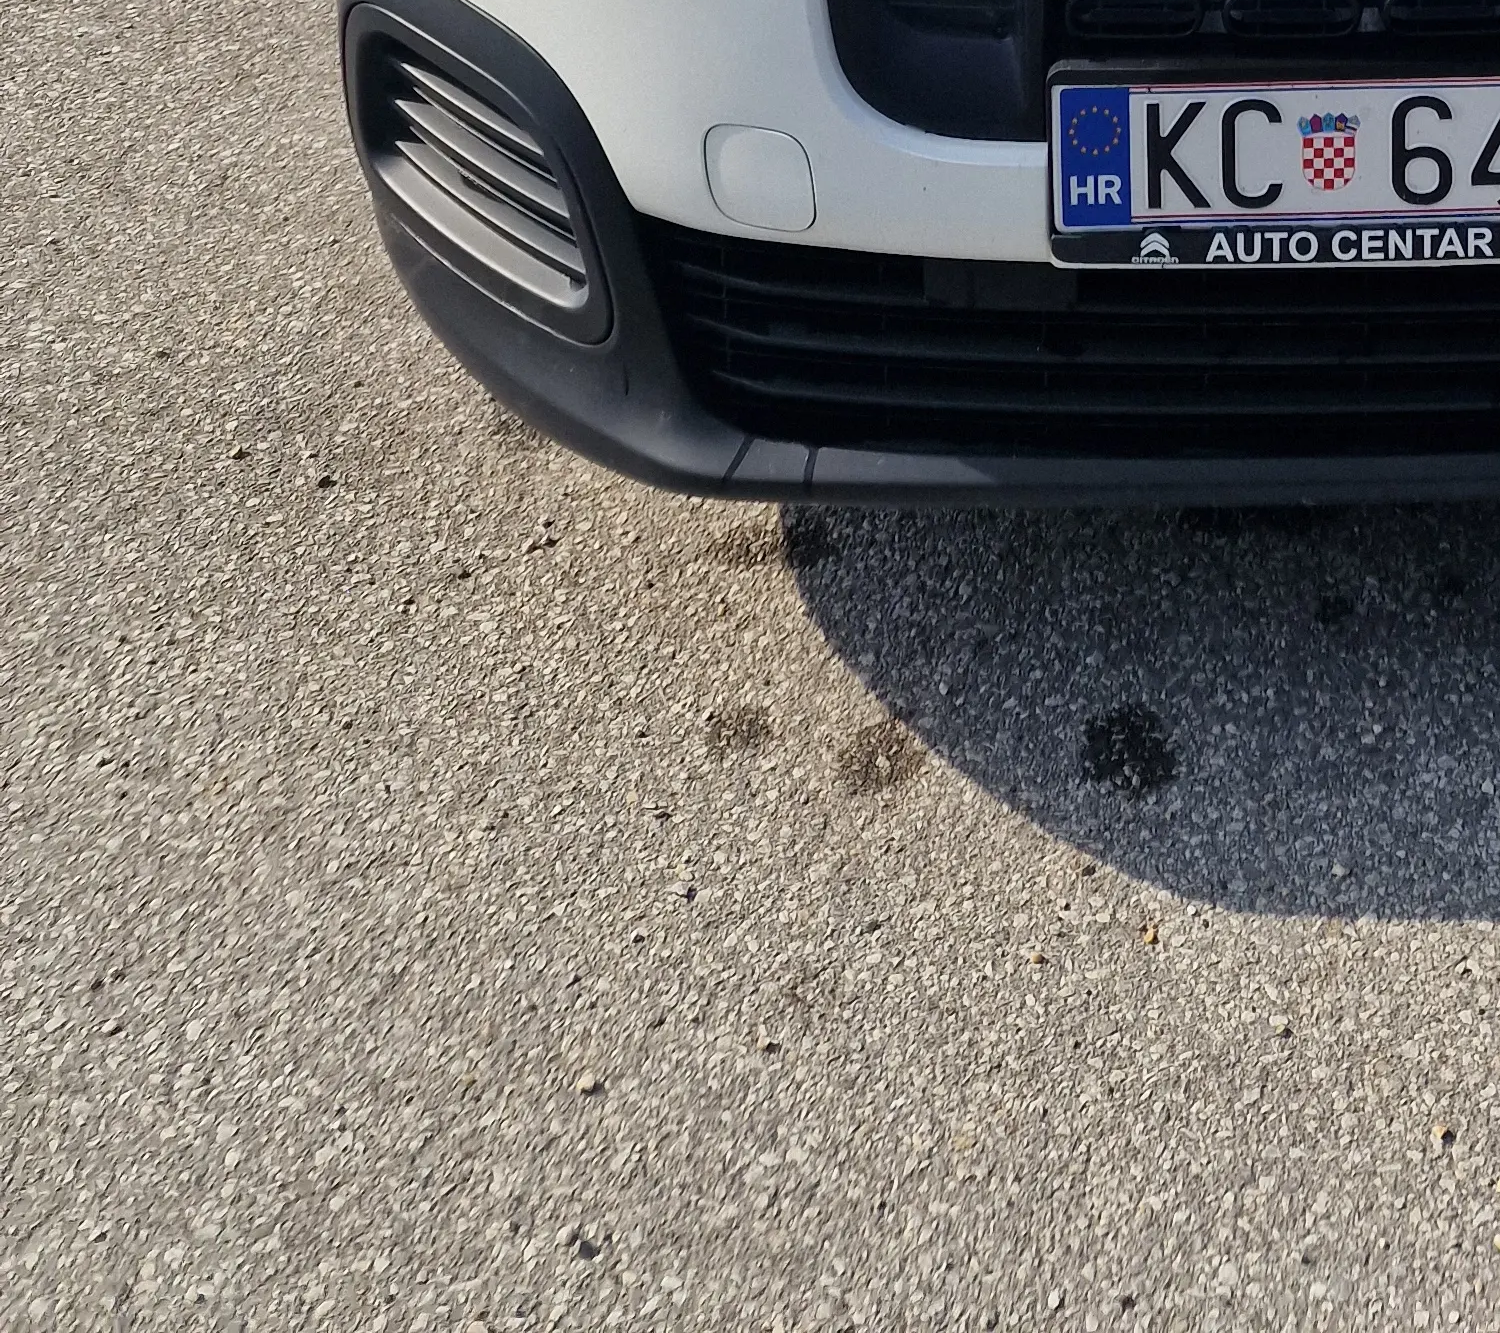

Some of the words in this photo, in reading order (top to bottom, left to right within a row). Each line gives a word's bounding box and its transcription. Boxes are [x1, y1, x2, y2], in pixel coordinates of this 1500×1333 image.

[1146, 98, 1283, 209] KC
[1070, 174, 1122, 206] HR
[1205, 232, 1318, 263] AUTO
[1331, 227, 1495, 262] CENTAR
